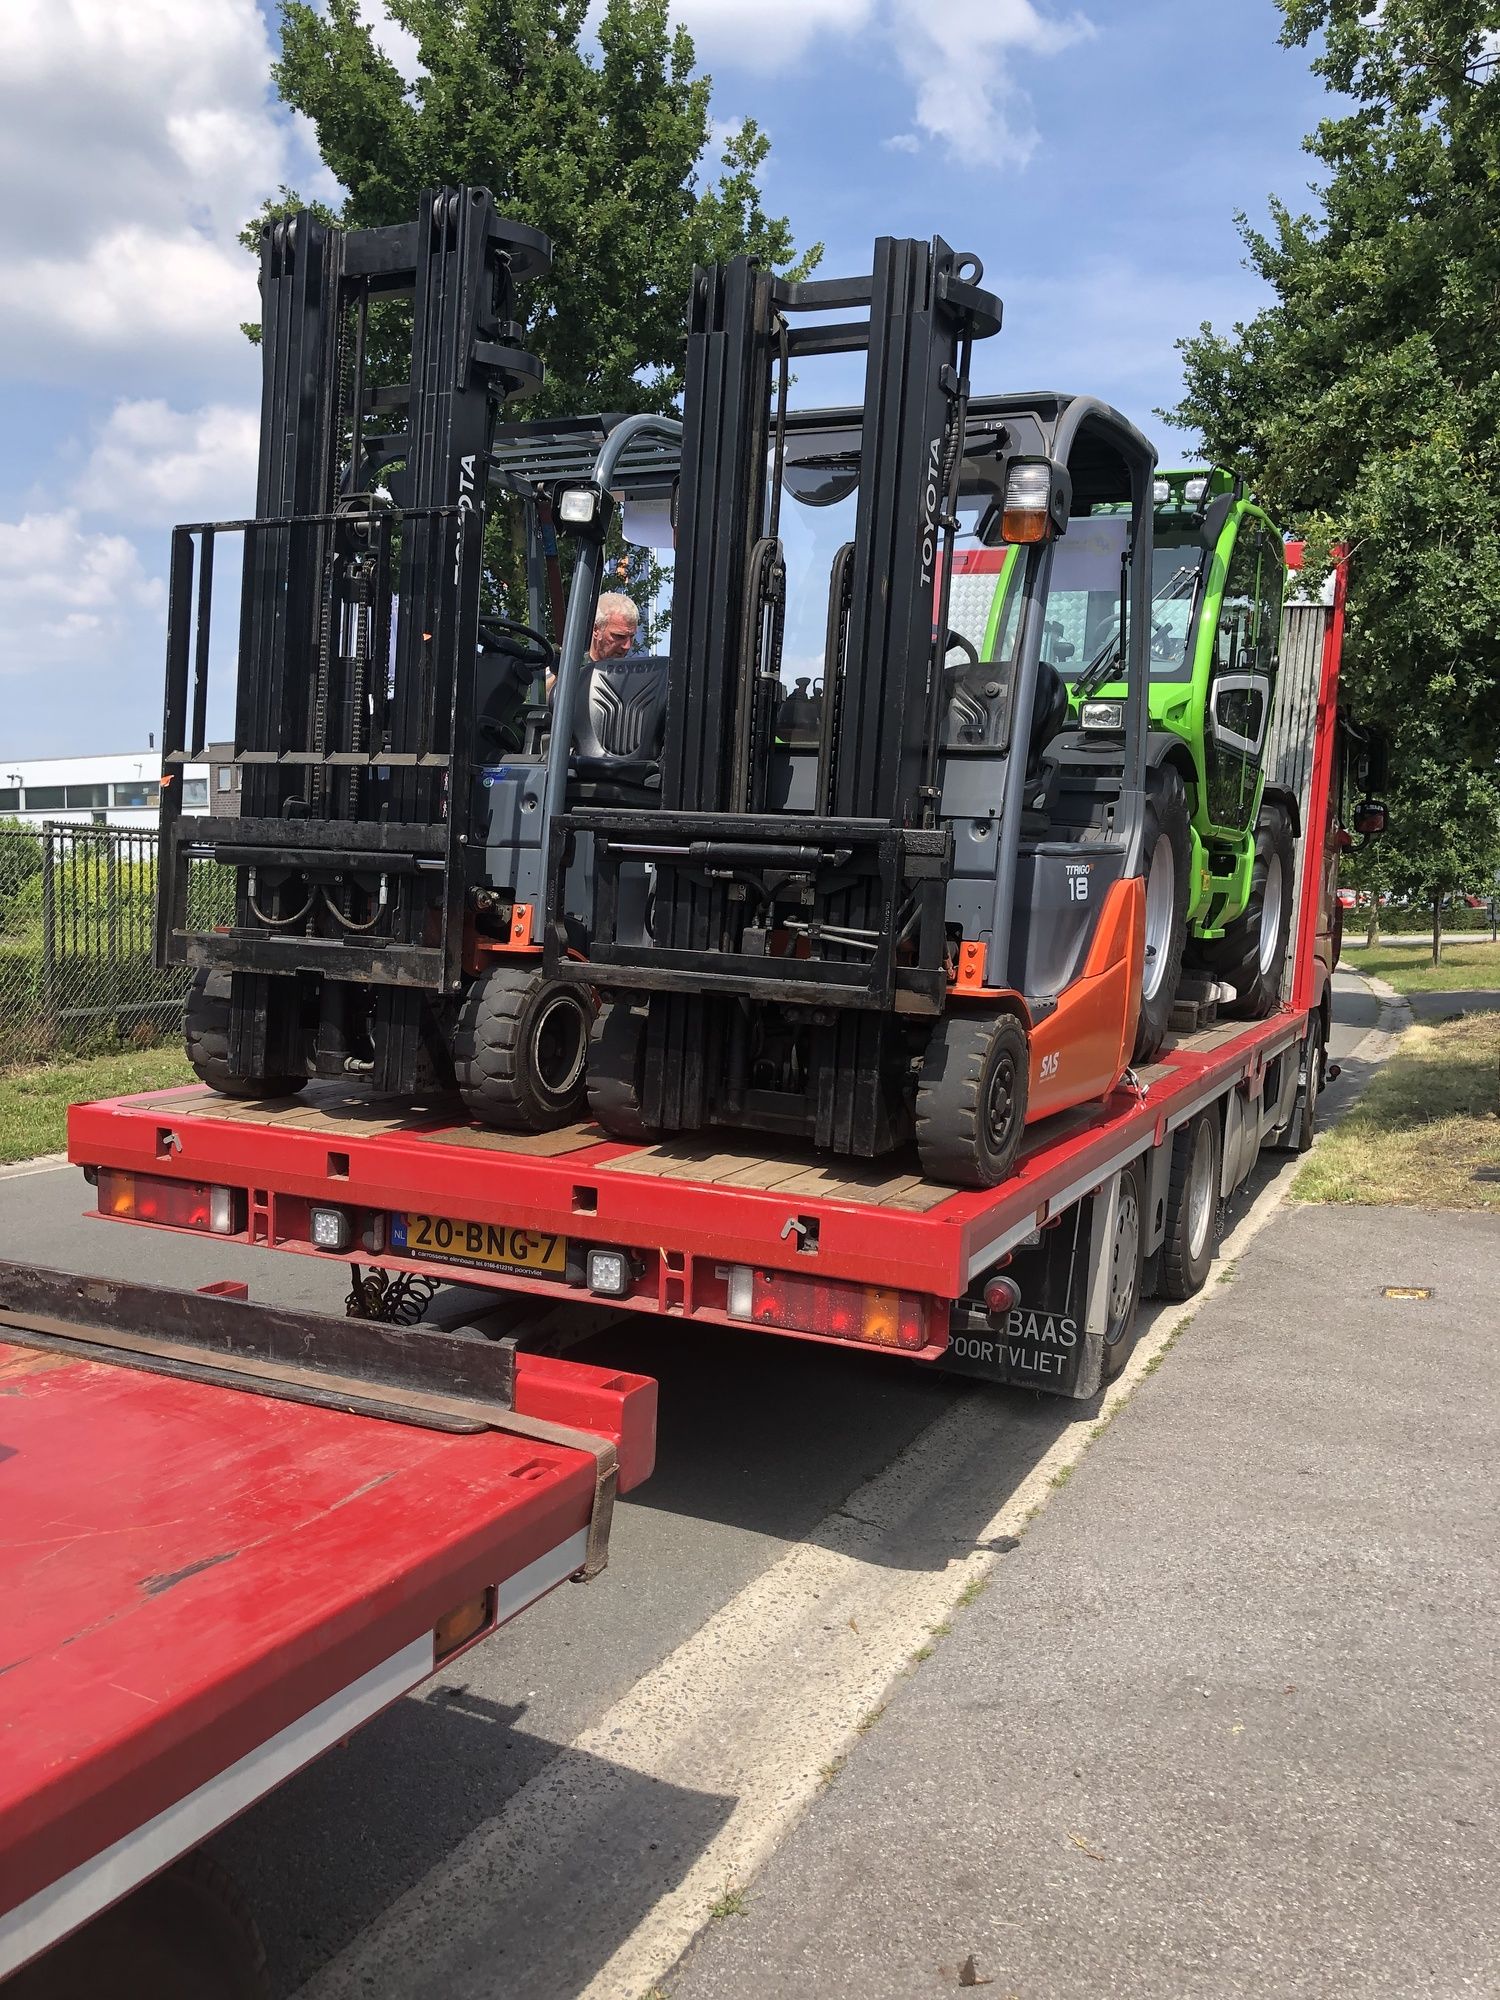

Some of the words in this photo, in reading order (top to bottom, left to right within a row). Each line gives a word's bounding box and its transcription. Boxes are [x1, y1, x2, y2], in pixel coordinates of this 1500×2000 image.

[454, 455, 476, 585] OTA
[920, 438, 941, 587] TOYOTA
[1069, 877, 1088, 900] 18
[1040, 1052, 1060, 1077] SAS
[394, 1229, 406, 1240] NL
[416, 1215, 558, 1264] 20-BNG-7
[514, 1266, 543, 1277] poortvliet
